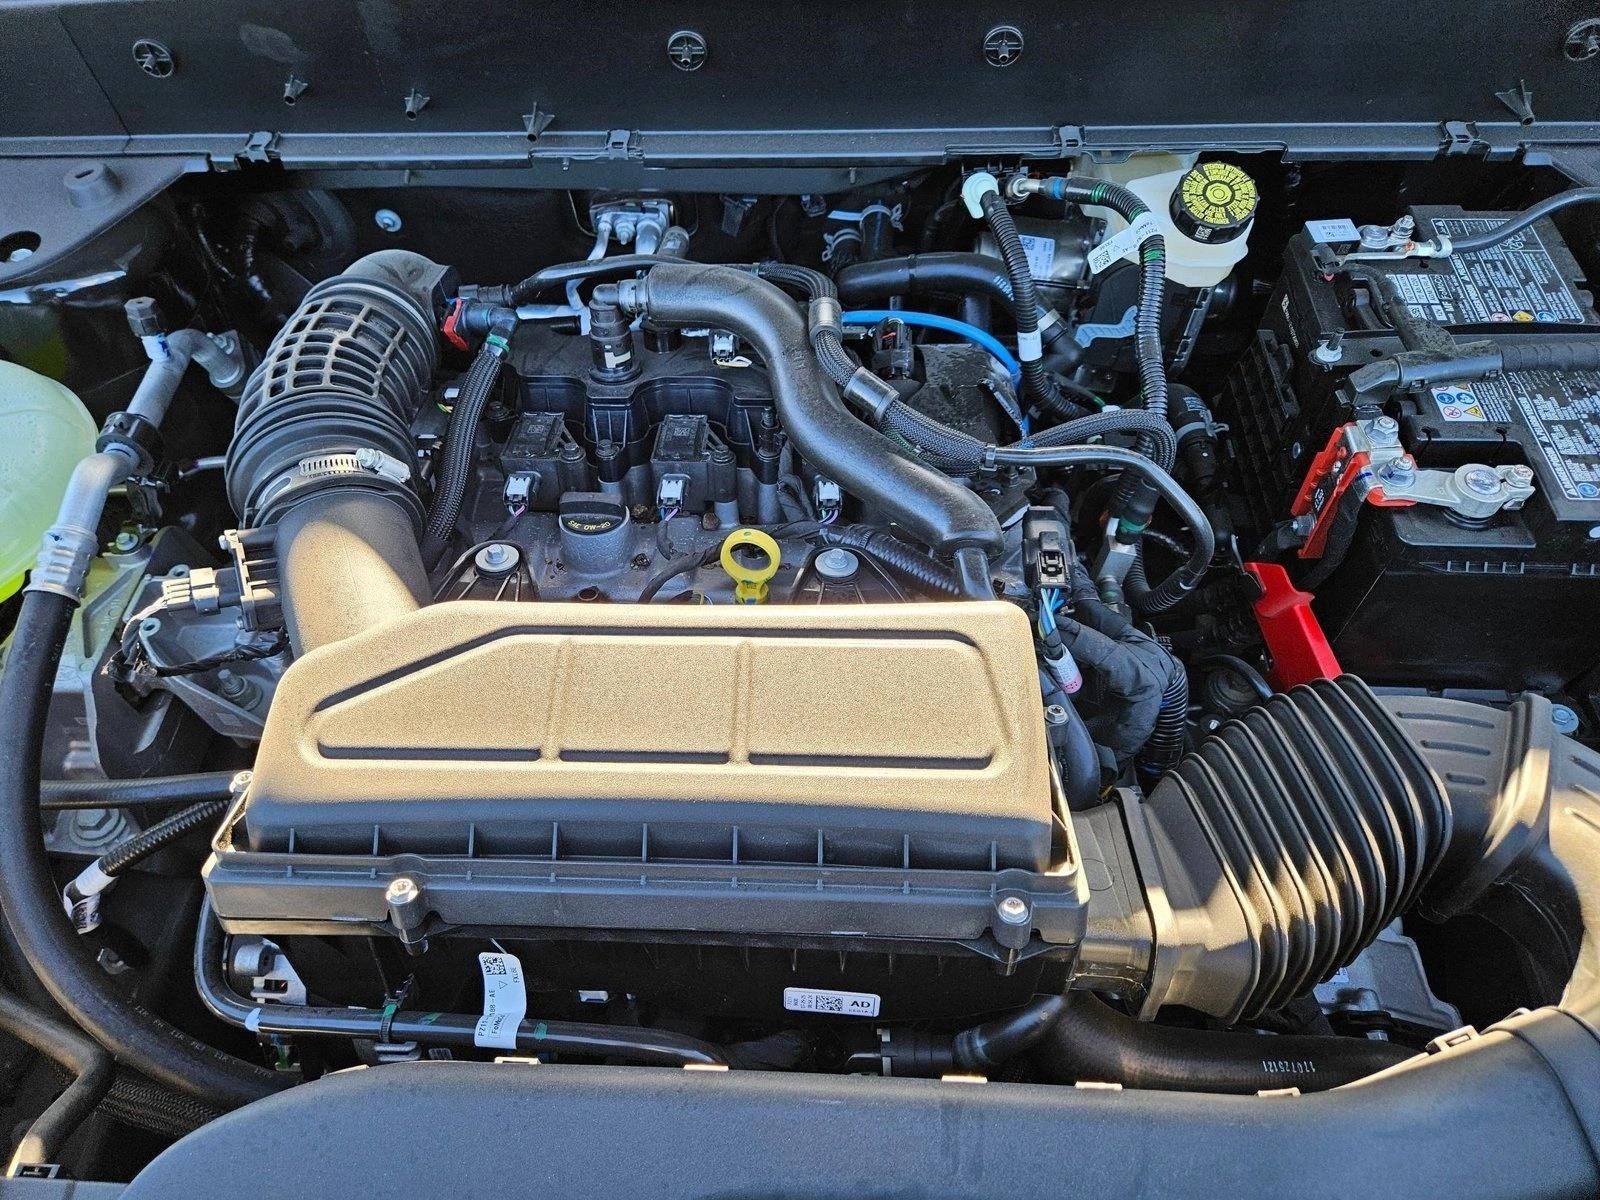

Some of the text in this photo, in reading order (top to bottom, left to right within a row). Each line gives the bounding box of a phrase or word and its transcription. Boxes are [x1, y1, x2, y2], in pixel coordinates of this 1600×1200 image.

[568, 520, 611, 531] SAE 0W-20
[850, 1000, 871, 1008] AD
